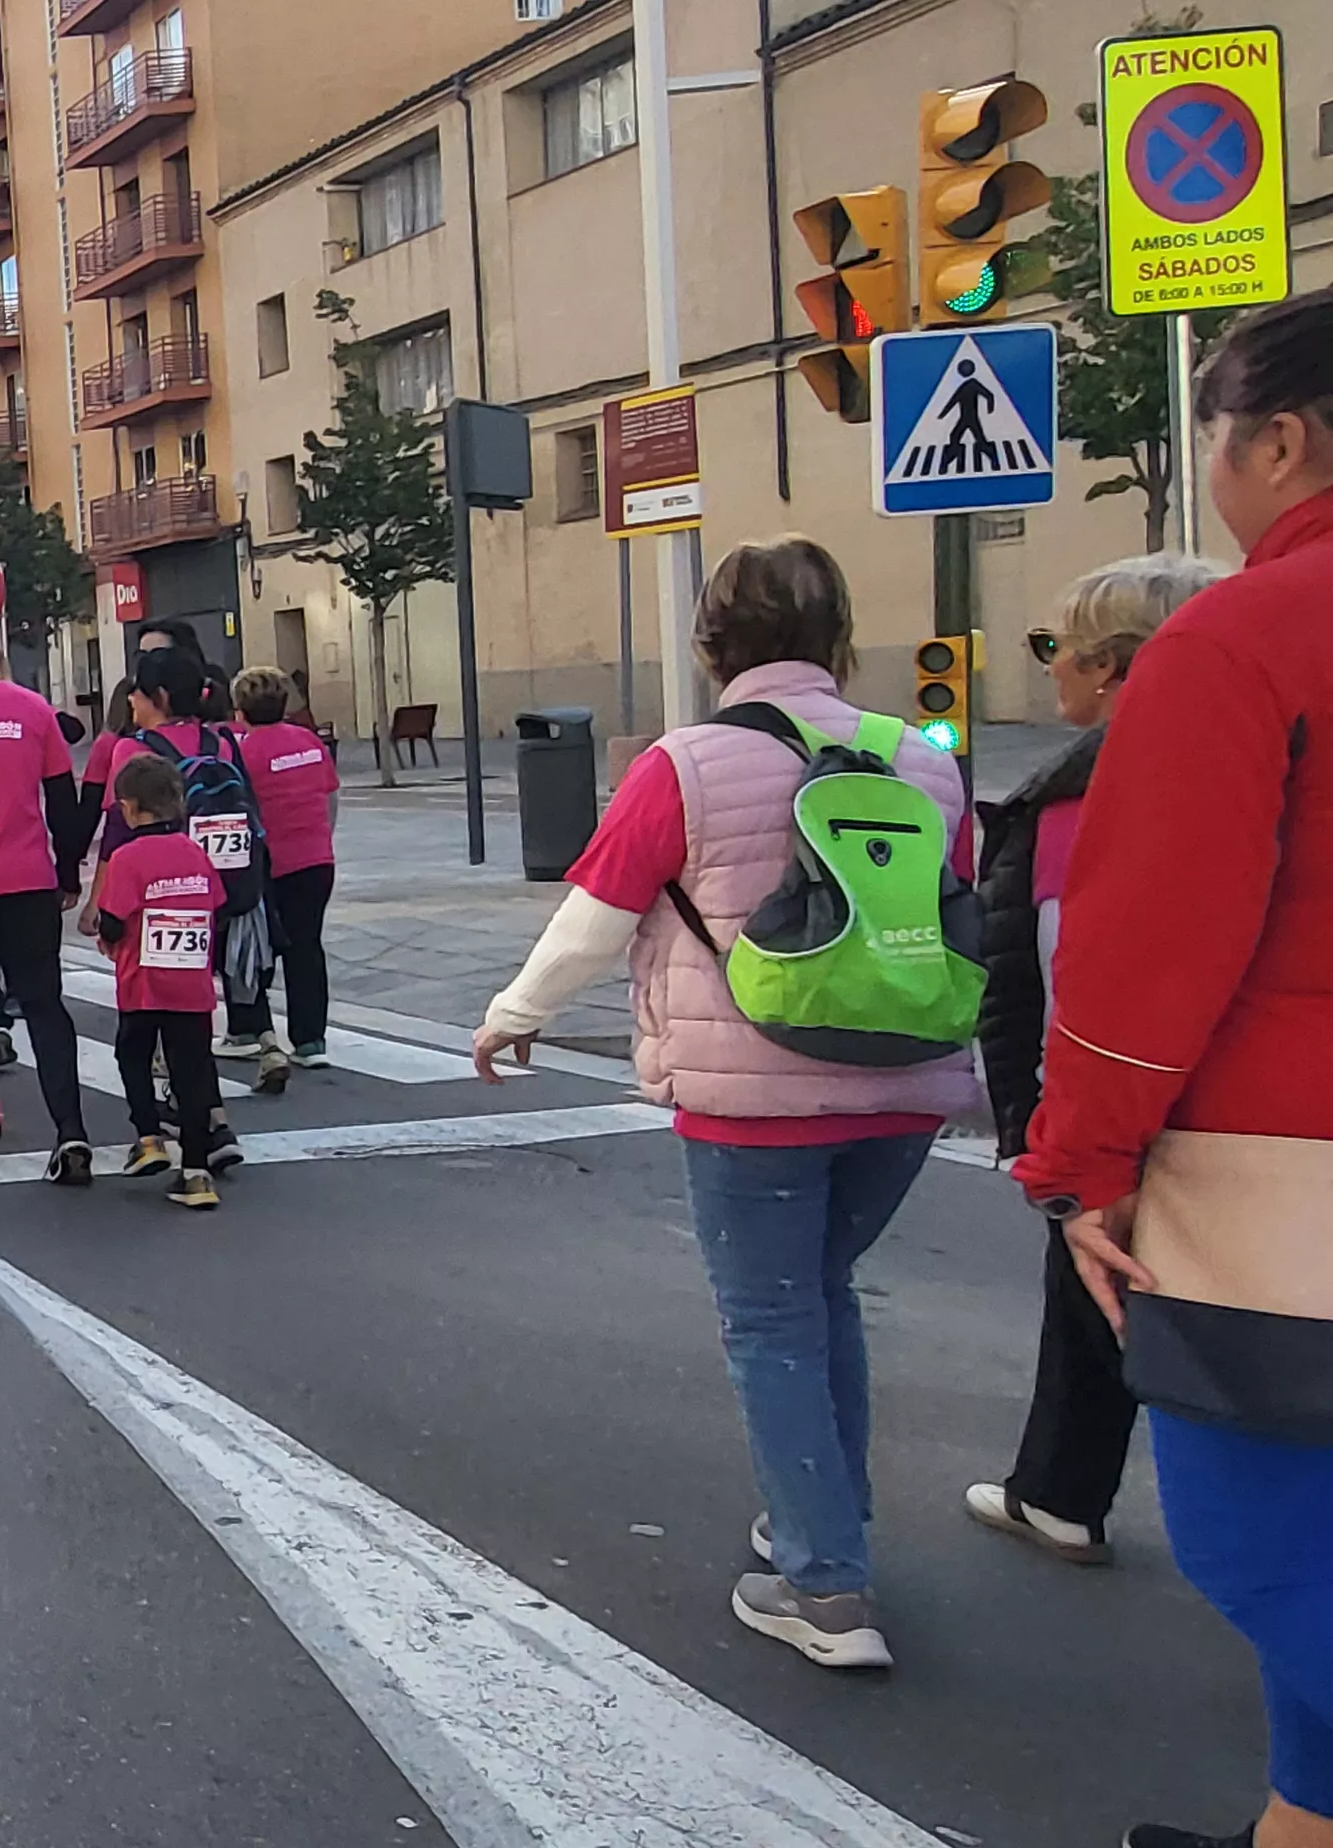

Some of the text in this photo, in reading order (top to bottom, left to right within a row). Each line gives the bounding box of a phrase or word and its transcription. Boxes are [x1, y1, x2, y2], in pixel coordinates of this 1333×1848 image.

[1111, 39, 1268, 78] ATENCIÓN
[1131, 226, 1265, 252] AMBOS LADOS
[1138, 252, 1257, 282] SÁBADOS
[1133, 289, 1155, 303] DE
[1193, 285, 1204, 298] A
[1251, 280, 1263, 293] H
[150, 930, 208, 952] 1736
